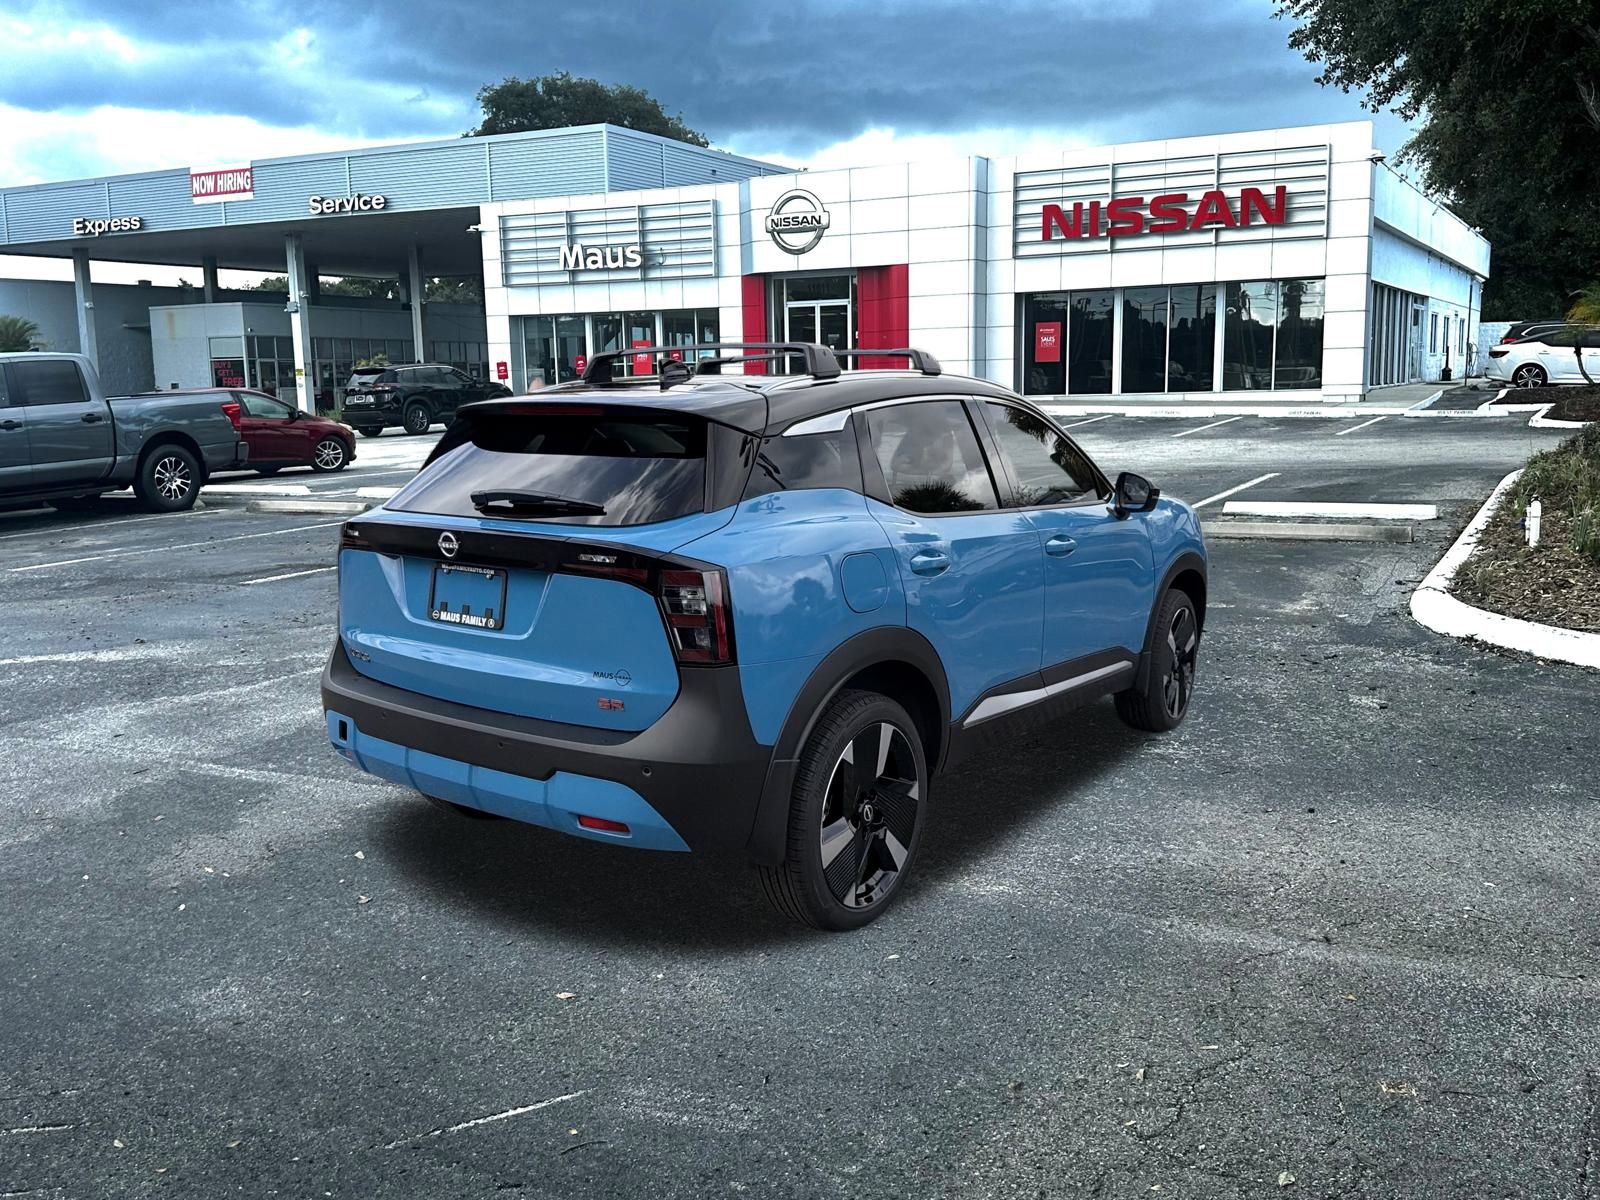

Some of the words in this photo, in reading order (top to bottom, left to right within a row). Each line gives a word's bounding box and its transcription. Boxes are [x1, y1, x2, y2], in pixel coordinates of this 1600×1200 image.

[192, 175, 214, 195] NOW
[217, 171, 251, 192] HIRING
[309, 193, 385, 215] Service
[1042, 185, 1287, 241] NISSAN
[73, 216, 141, 236] Express
[770, 214, 822, 229] NISSAN
[558, 243, 642, 271] Maus
[223, 377, 244, 387] FREE
[440, 611, 460, 624] MAUS
[461, 614, 487, 627] FAMILY
[592, 671, 614, 680] MAUS
